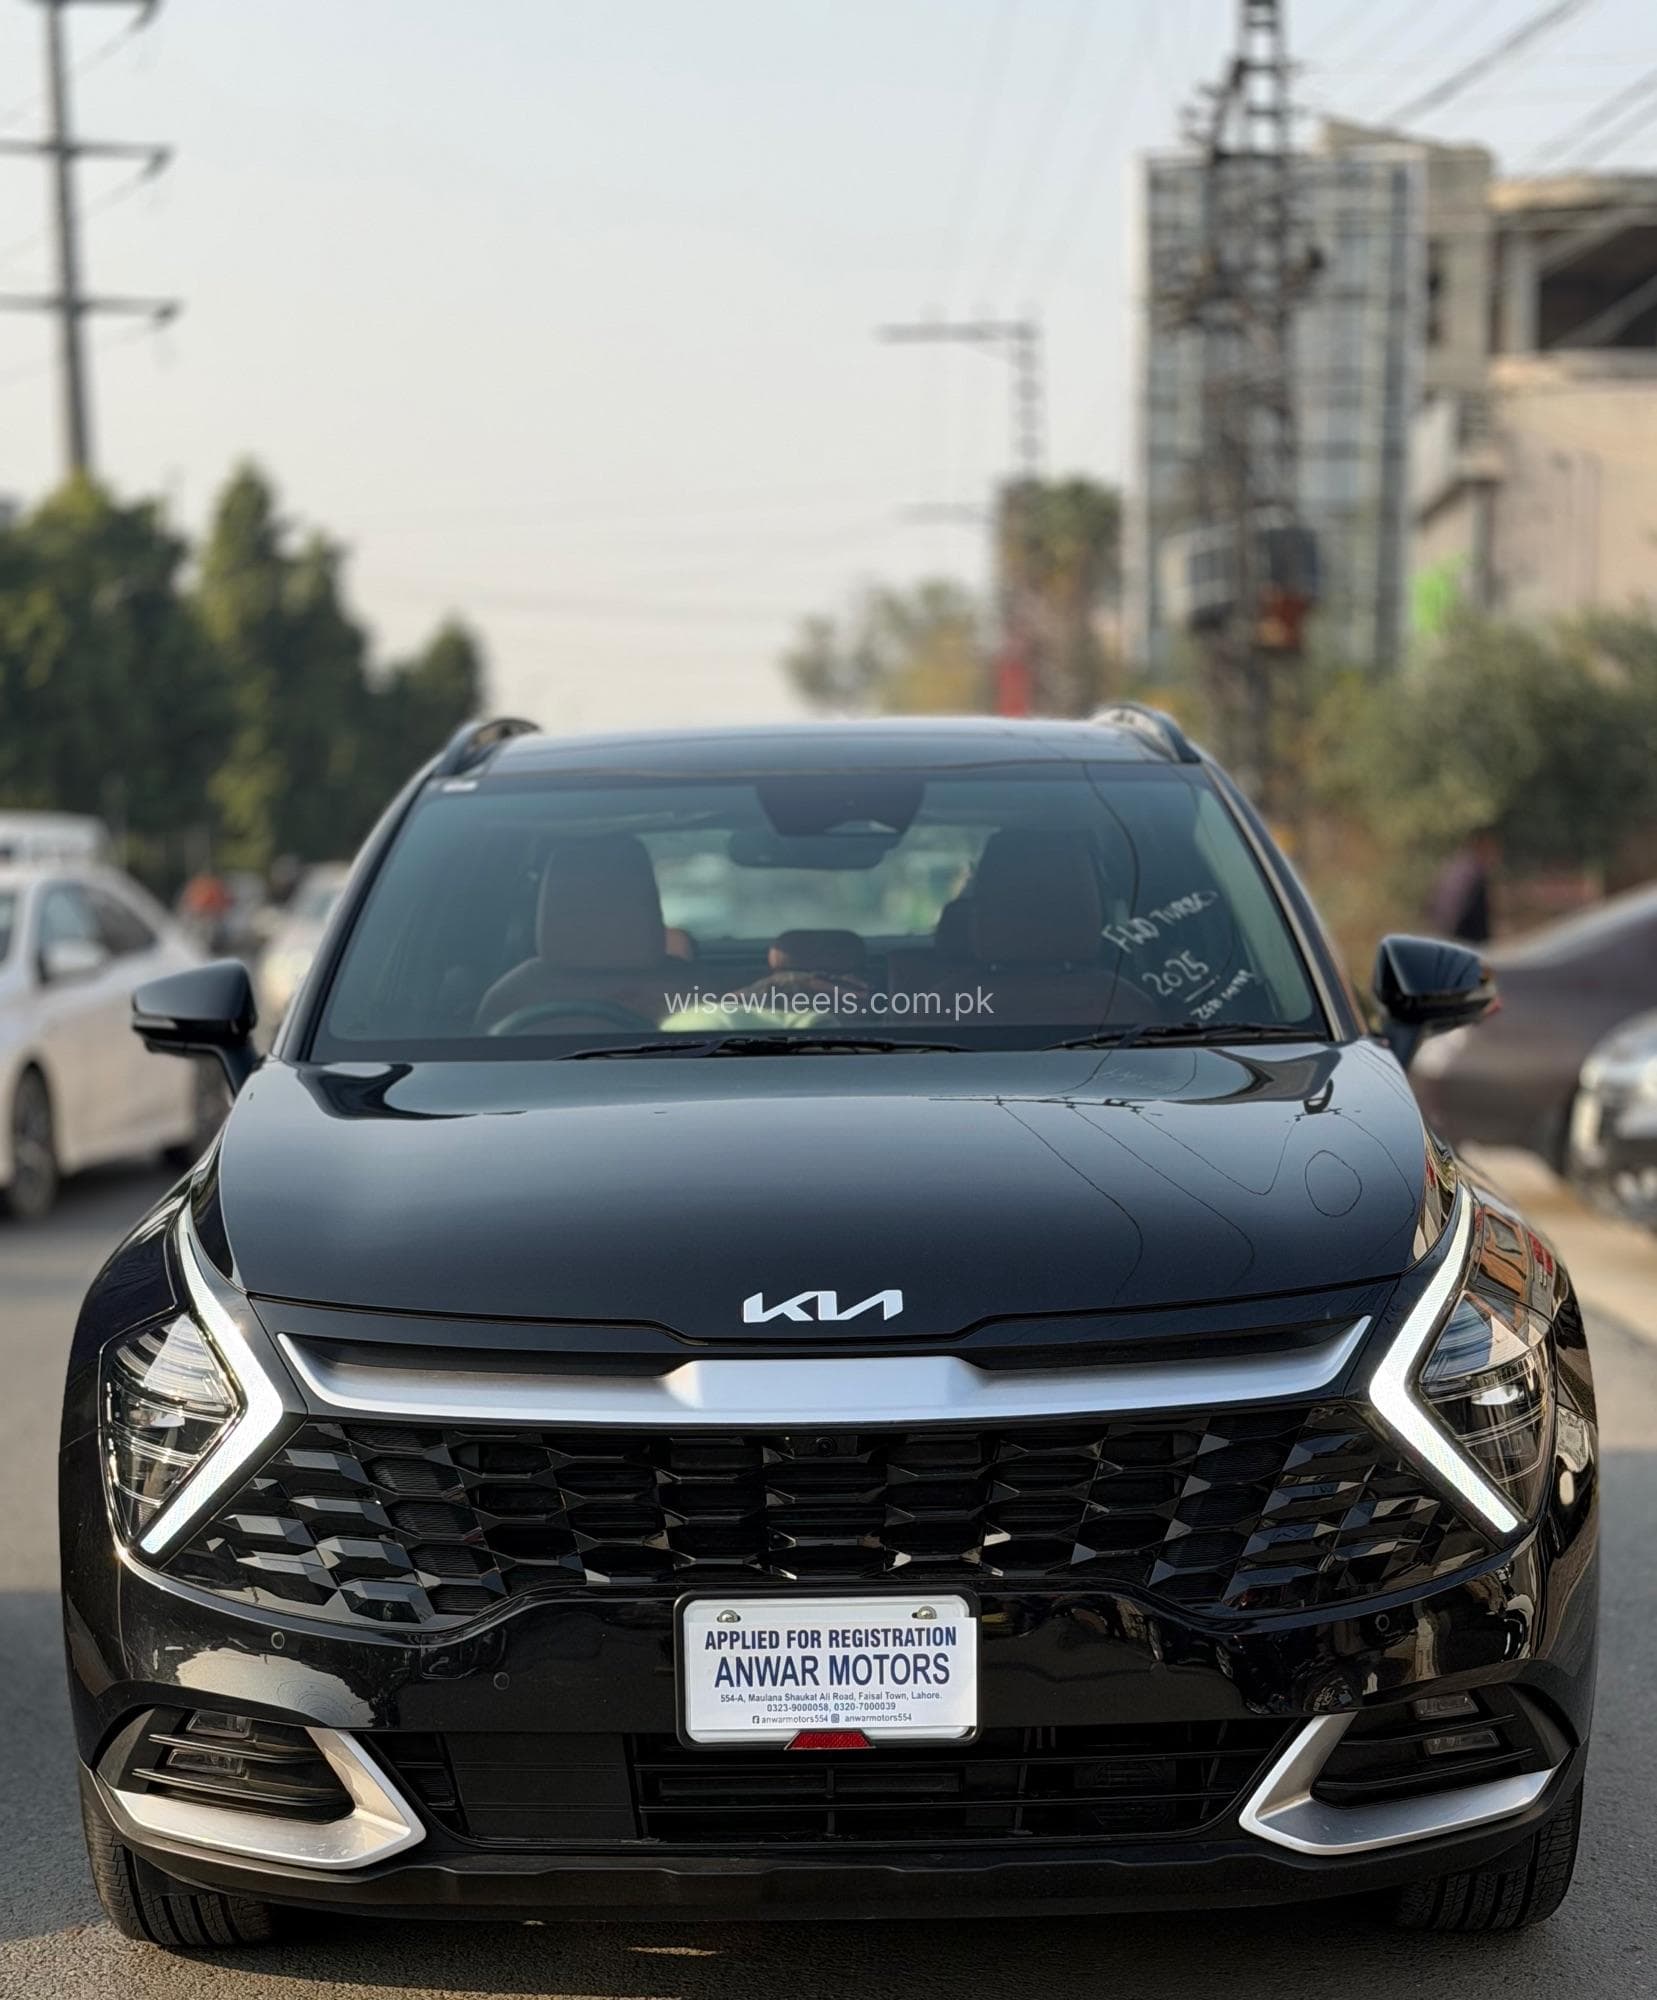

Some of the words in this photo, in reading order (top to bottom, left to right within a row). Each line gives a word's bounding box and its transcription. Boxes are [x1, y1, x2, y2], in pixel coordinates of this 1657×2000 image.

[1141, 950, 1209, 996] 2025
[743, 1289, 904, 1324] KIA
[704, 1630, 780, 1651] APPLIED
[786, 1629, 822, 1649] FOR
[828, 1626, 957, 1649] REGISTRATION
[714, 1655, 820, 1688] ANWAR
[829, 1652, 950, 1686] MOTORS
[720, 1694, 746, 1704] 554-A,
[748, 1692, 783, 1702] Maulana
[784, 1692, 818, 1702] Shaukat
[819, 1691, 831, 1701] Ali
[832, 1691, 857, 1702] Road,
[858, 1691, 883, 1701] Faisal
[884, 1690, 910, 1702] Town,
[911, 1690, 942, 1700] Lahore.
[761, 1714, 828, 1724] anwarmotors554
[844, 1713, 912, 1723] anwarmotors554
